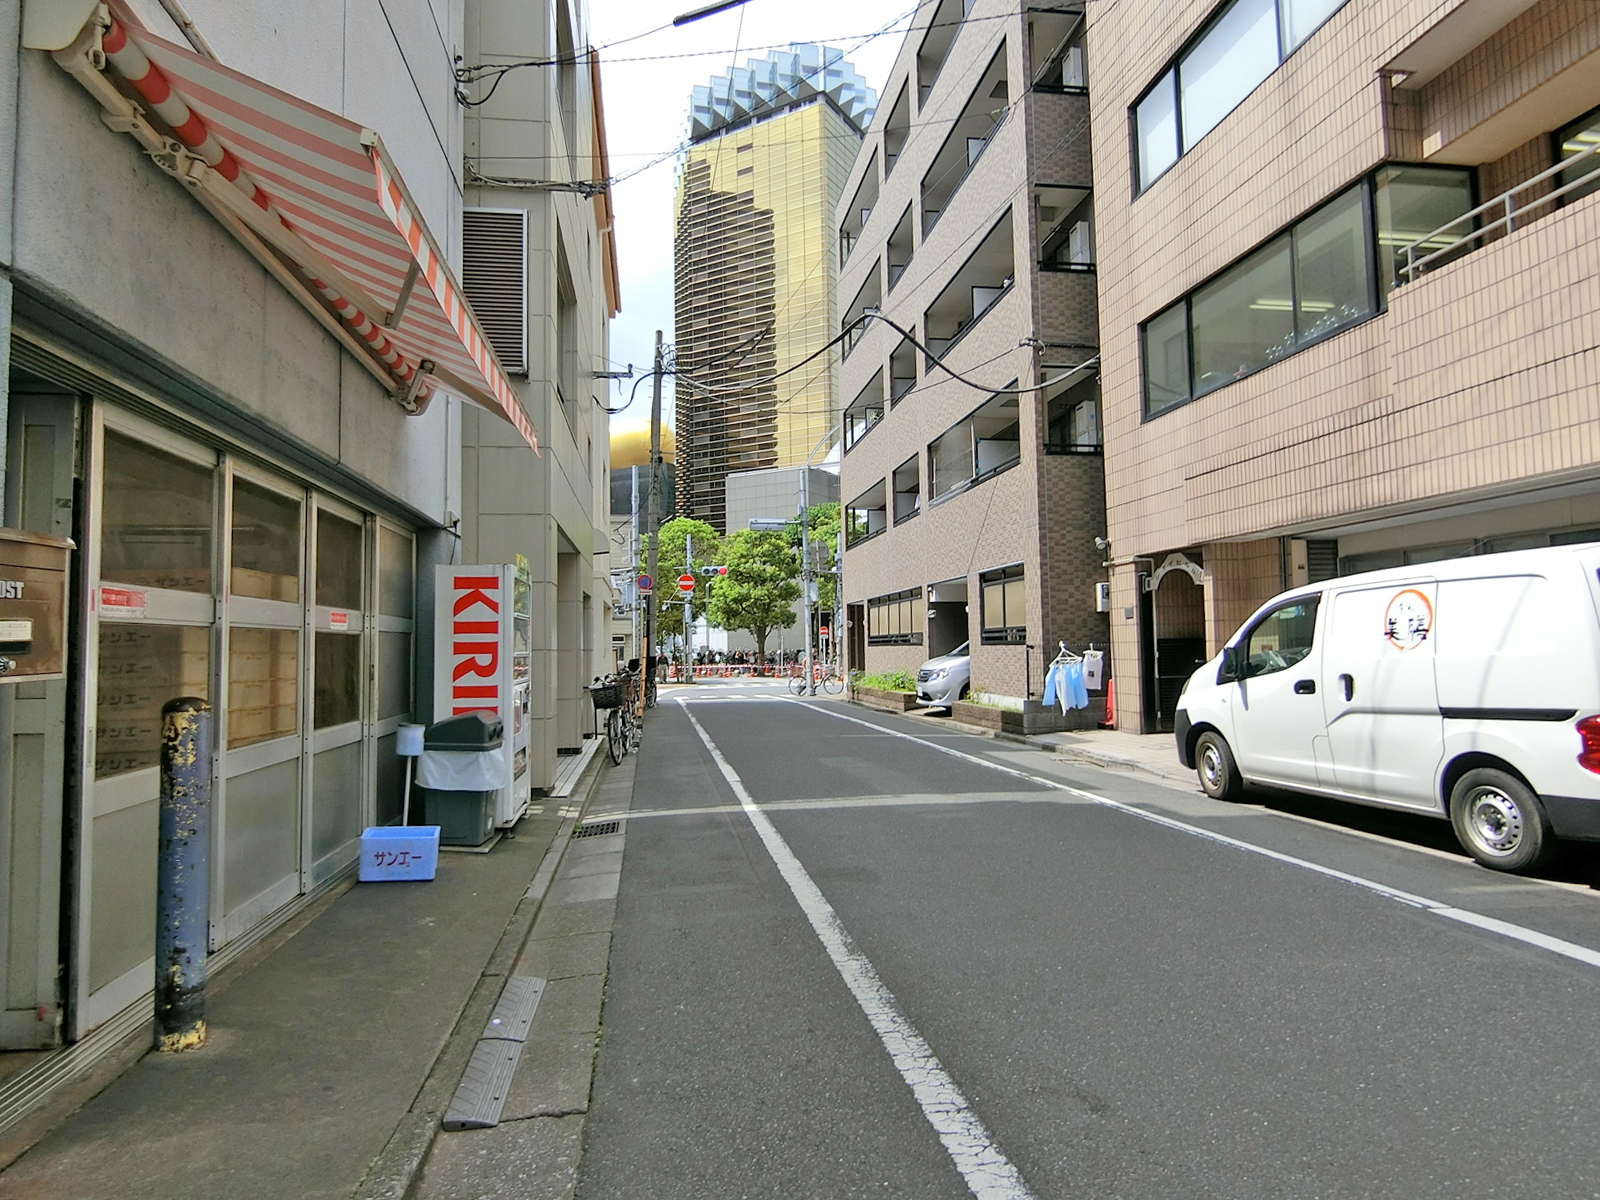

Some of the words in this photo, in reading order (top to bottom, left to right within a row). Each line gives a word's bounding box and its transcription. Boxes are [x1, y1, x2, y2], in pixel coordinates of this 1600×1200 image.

[453, 576, 499, 716] KIRI
[374, 851, 422, 867] サンエー
